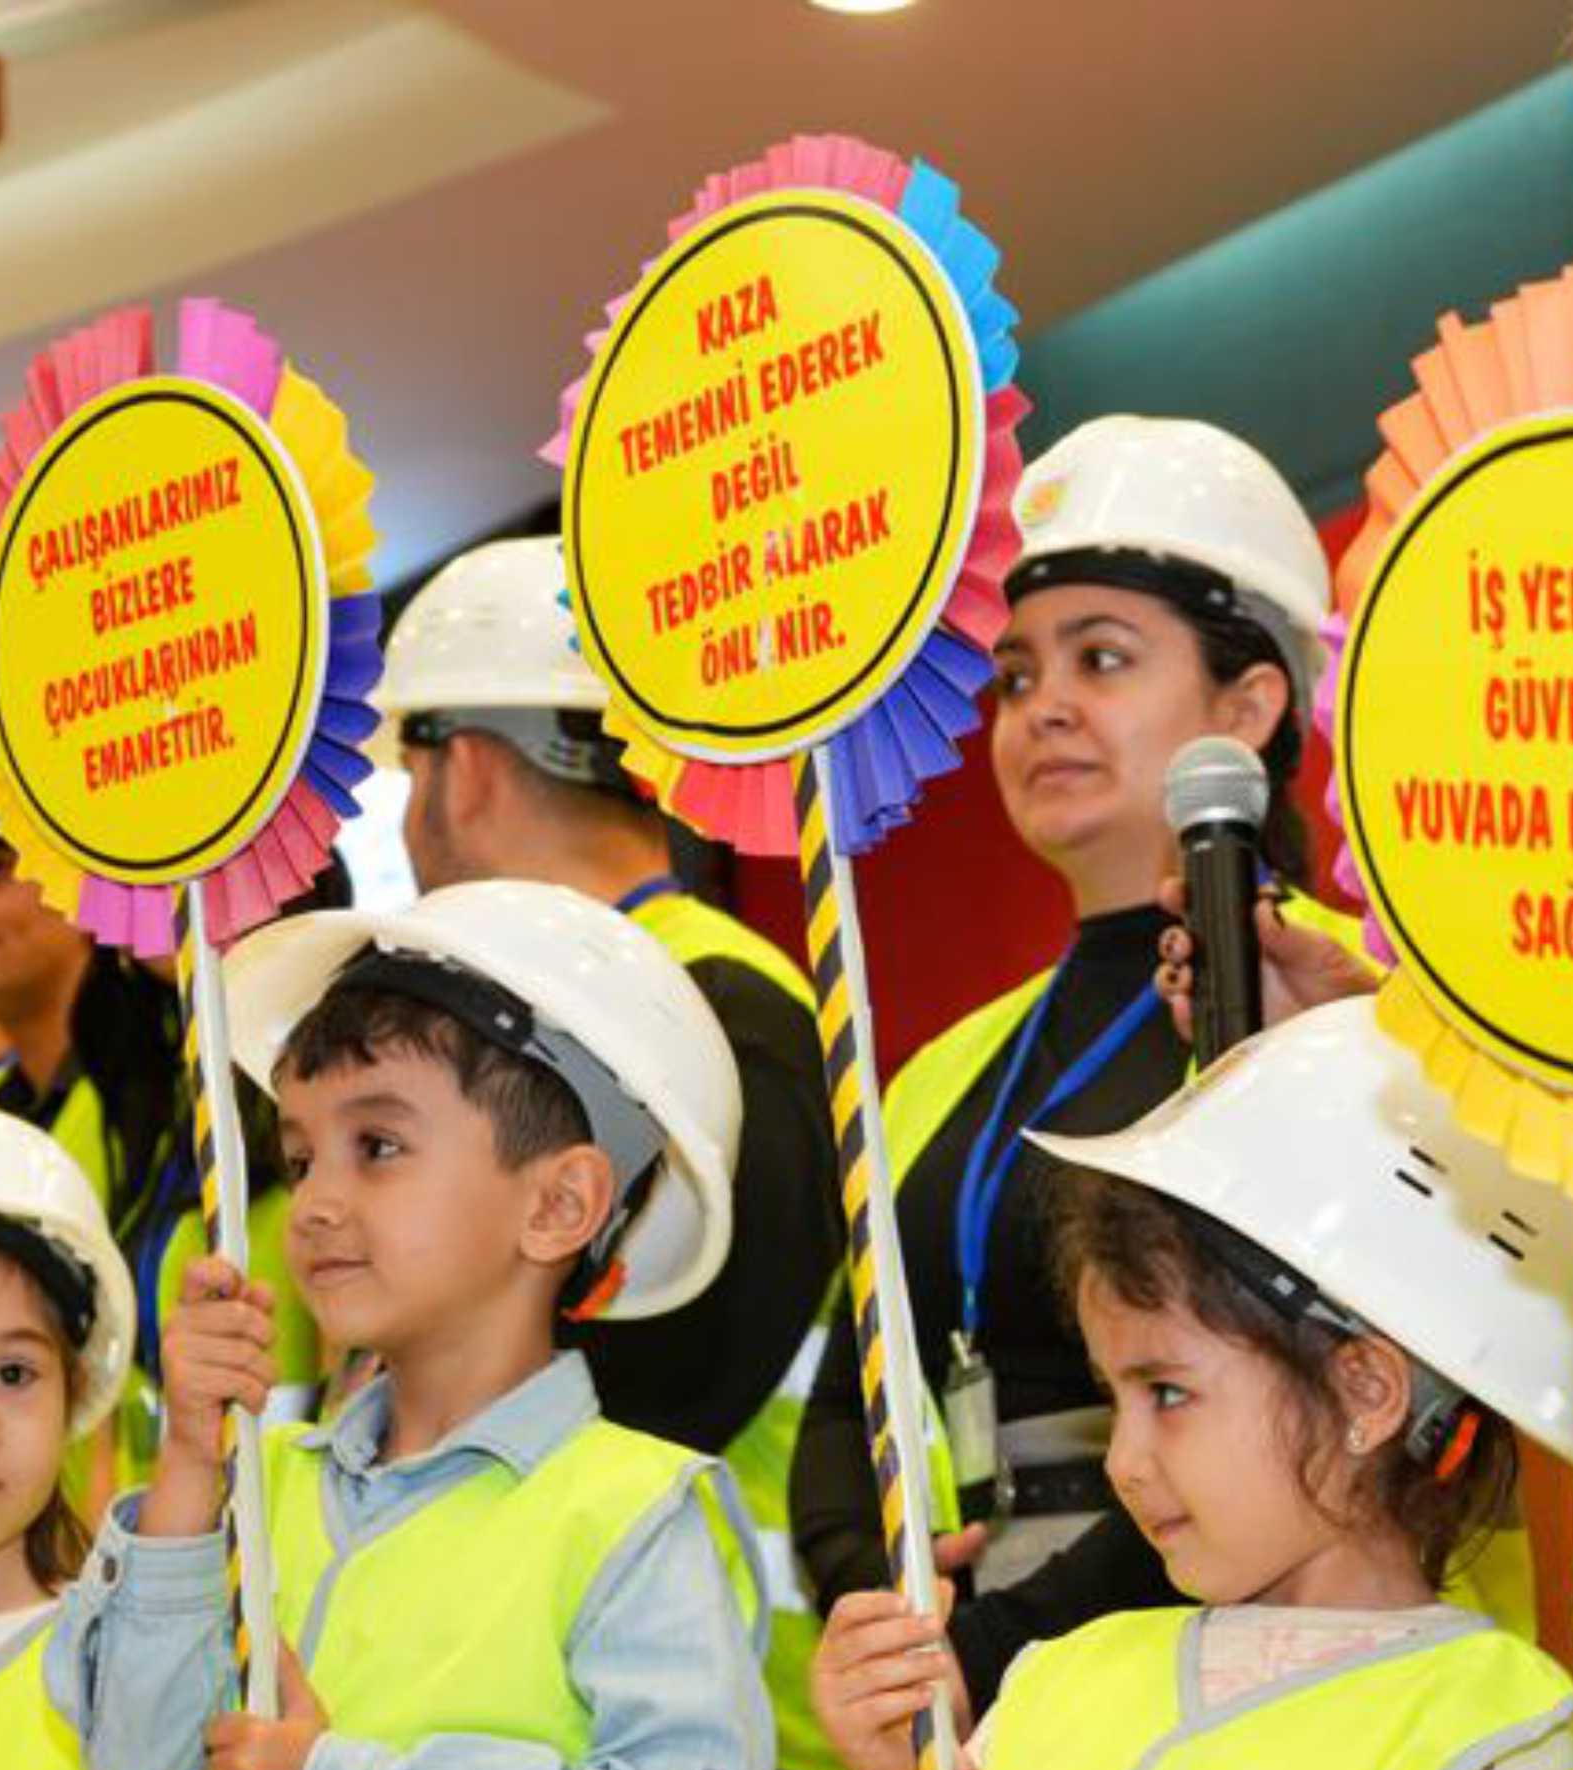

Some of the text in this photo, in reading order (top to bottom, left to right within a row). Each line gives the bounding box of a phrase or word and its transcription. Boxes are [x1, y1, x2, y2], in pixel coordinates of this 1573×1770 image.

[695, 275, 778, 355] KAZA
[619, 311, 884, 477] TEMENNİ EDEREK
[28, 458, 241, 593] ÇALIŞANLARIMIZ
[711, 431, 800, 524] DEĞİL
[91, 556, 195, 637] BİZLERE
[646, 540, 753, 636] TEDBİR
[1468, 548, 1506, 650] İŞ
[44, 610, 257, 740] ÇOCUKLARINDAN
[700, 593, 846, 688] ÖNLNİR.
[83, 697, 235, 794] EMANETTİR.
[1394, 777, 1553, 852] YUVADA
